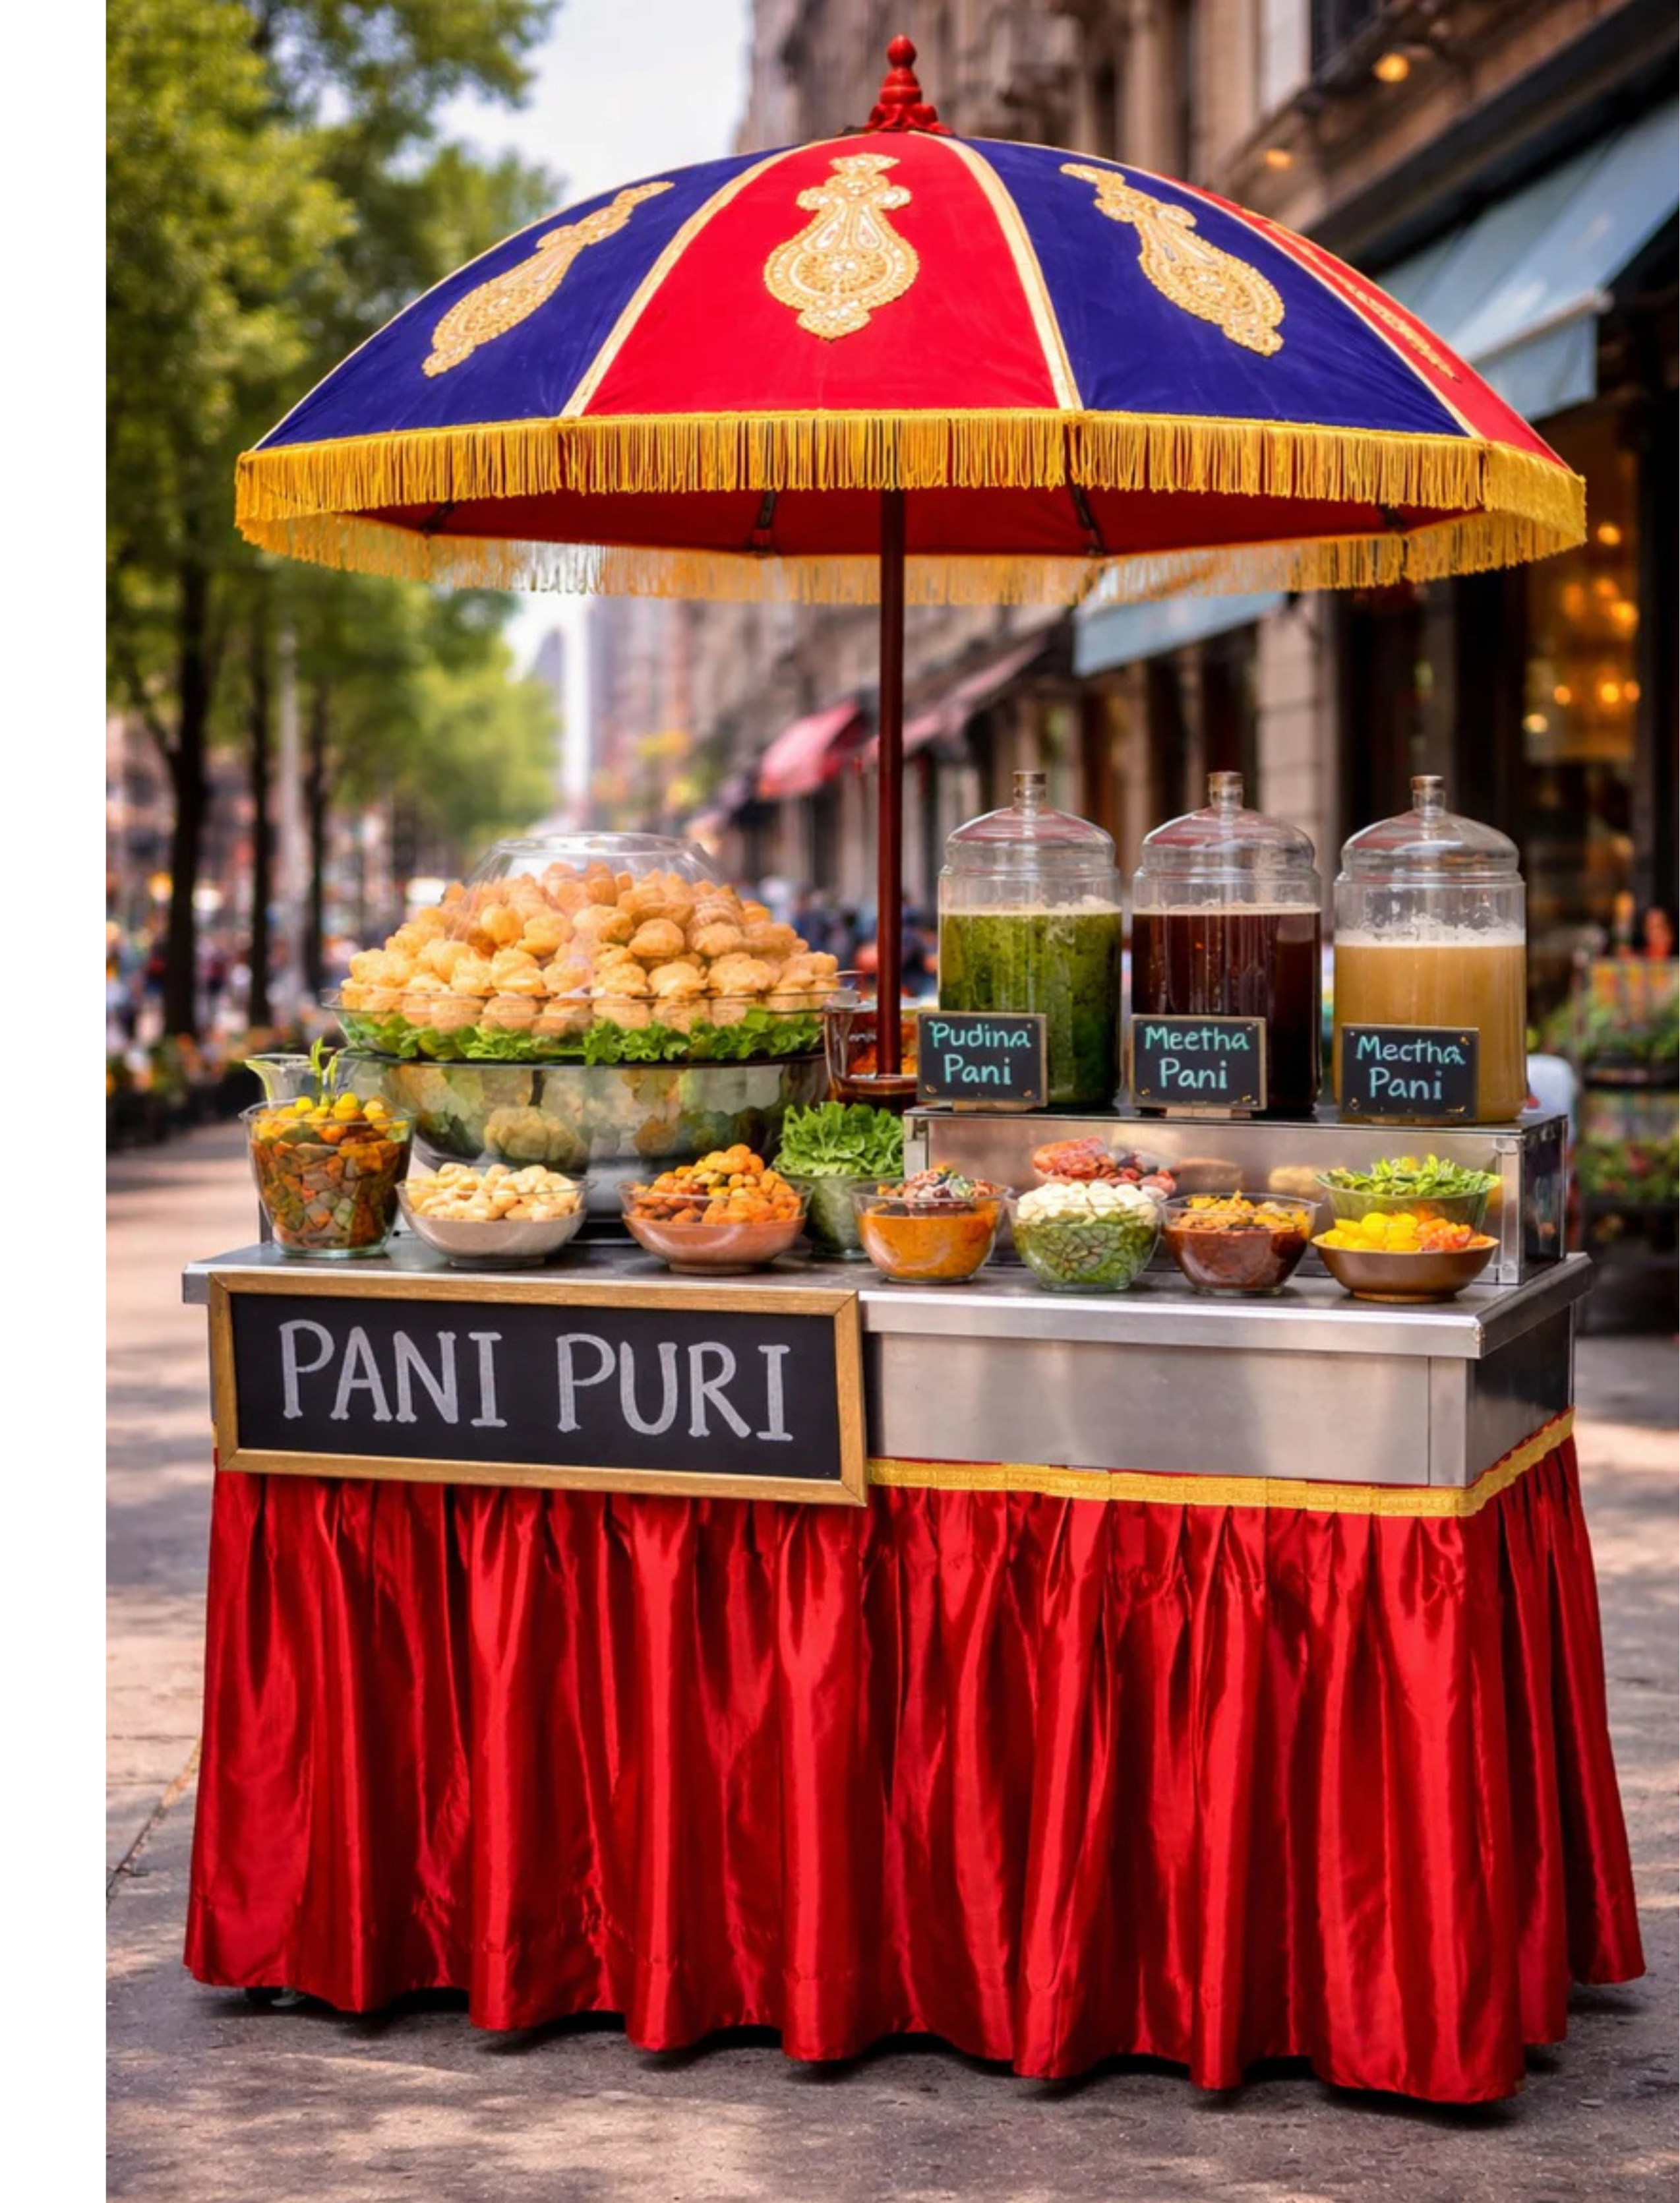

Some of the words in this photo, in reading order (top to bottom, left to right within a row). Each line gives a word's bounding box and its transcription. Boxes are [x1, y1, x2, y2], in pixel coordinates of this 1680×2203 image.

[928, 1021, 1031, 1048] Pudina
[1145, 1025, 1250, 1051] Meetha
[944, 1054, 1012, 1085] Pani
[1159, 1058, 1228, 1089] Pani
[1369, 1067, 1443, 1100] Pani
[280, 1319, 508, 1428] PANI
[556, 1333, 794, 1441] PURI
